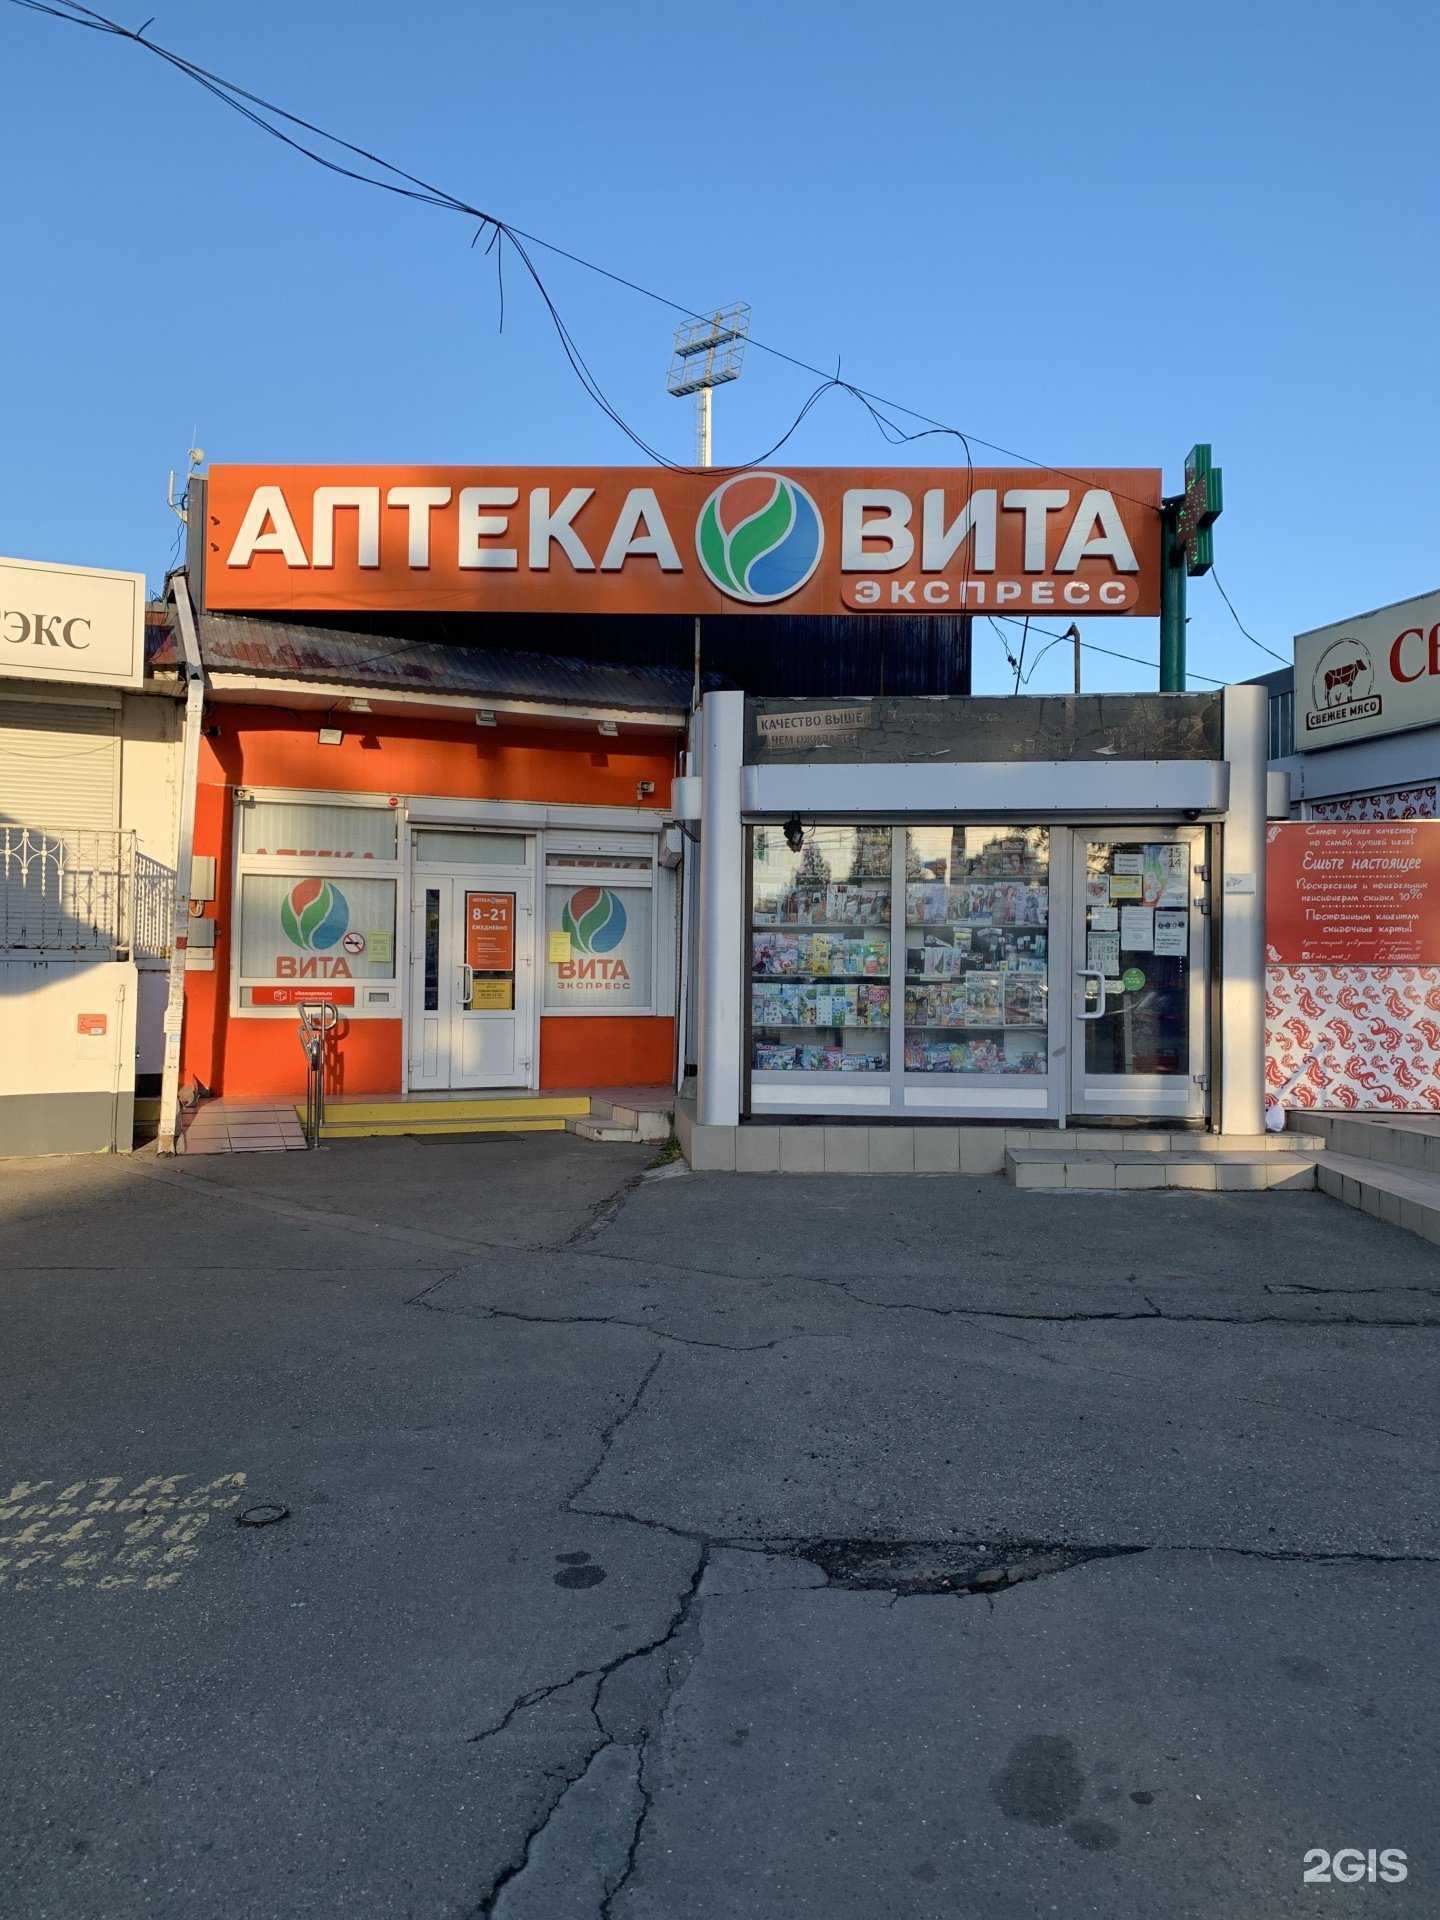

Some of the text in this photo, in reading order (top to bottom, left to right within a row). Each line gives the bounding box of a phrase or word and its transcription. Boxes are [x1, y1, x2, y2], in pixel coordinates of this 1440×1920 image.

[226, 486, 683, 573] АПТЕКА
[840, 488, 1140, 574] ВИТА
[853, 580, 1127, 605] ЭКСПРЕСС
[0, 611, 91, 650] ЭКС
[761, 717, 821, 730] КАЧЕСТВО
[1310, 701, 1377, 726] СВЕЖЕЕ МЯСО
[771, 735, 794, 746] ЧЕМ
[1303, 851, 1421, 872] Ешьте настоящее
[1305, 908, 1371, 921] Постоянным
[275, 955, 353, 979] ВИТА
[557, 958, 630, 980] ВИТА
[557, 981, 631, 990] ЭКСПРЕСС
